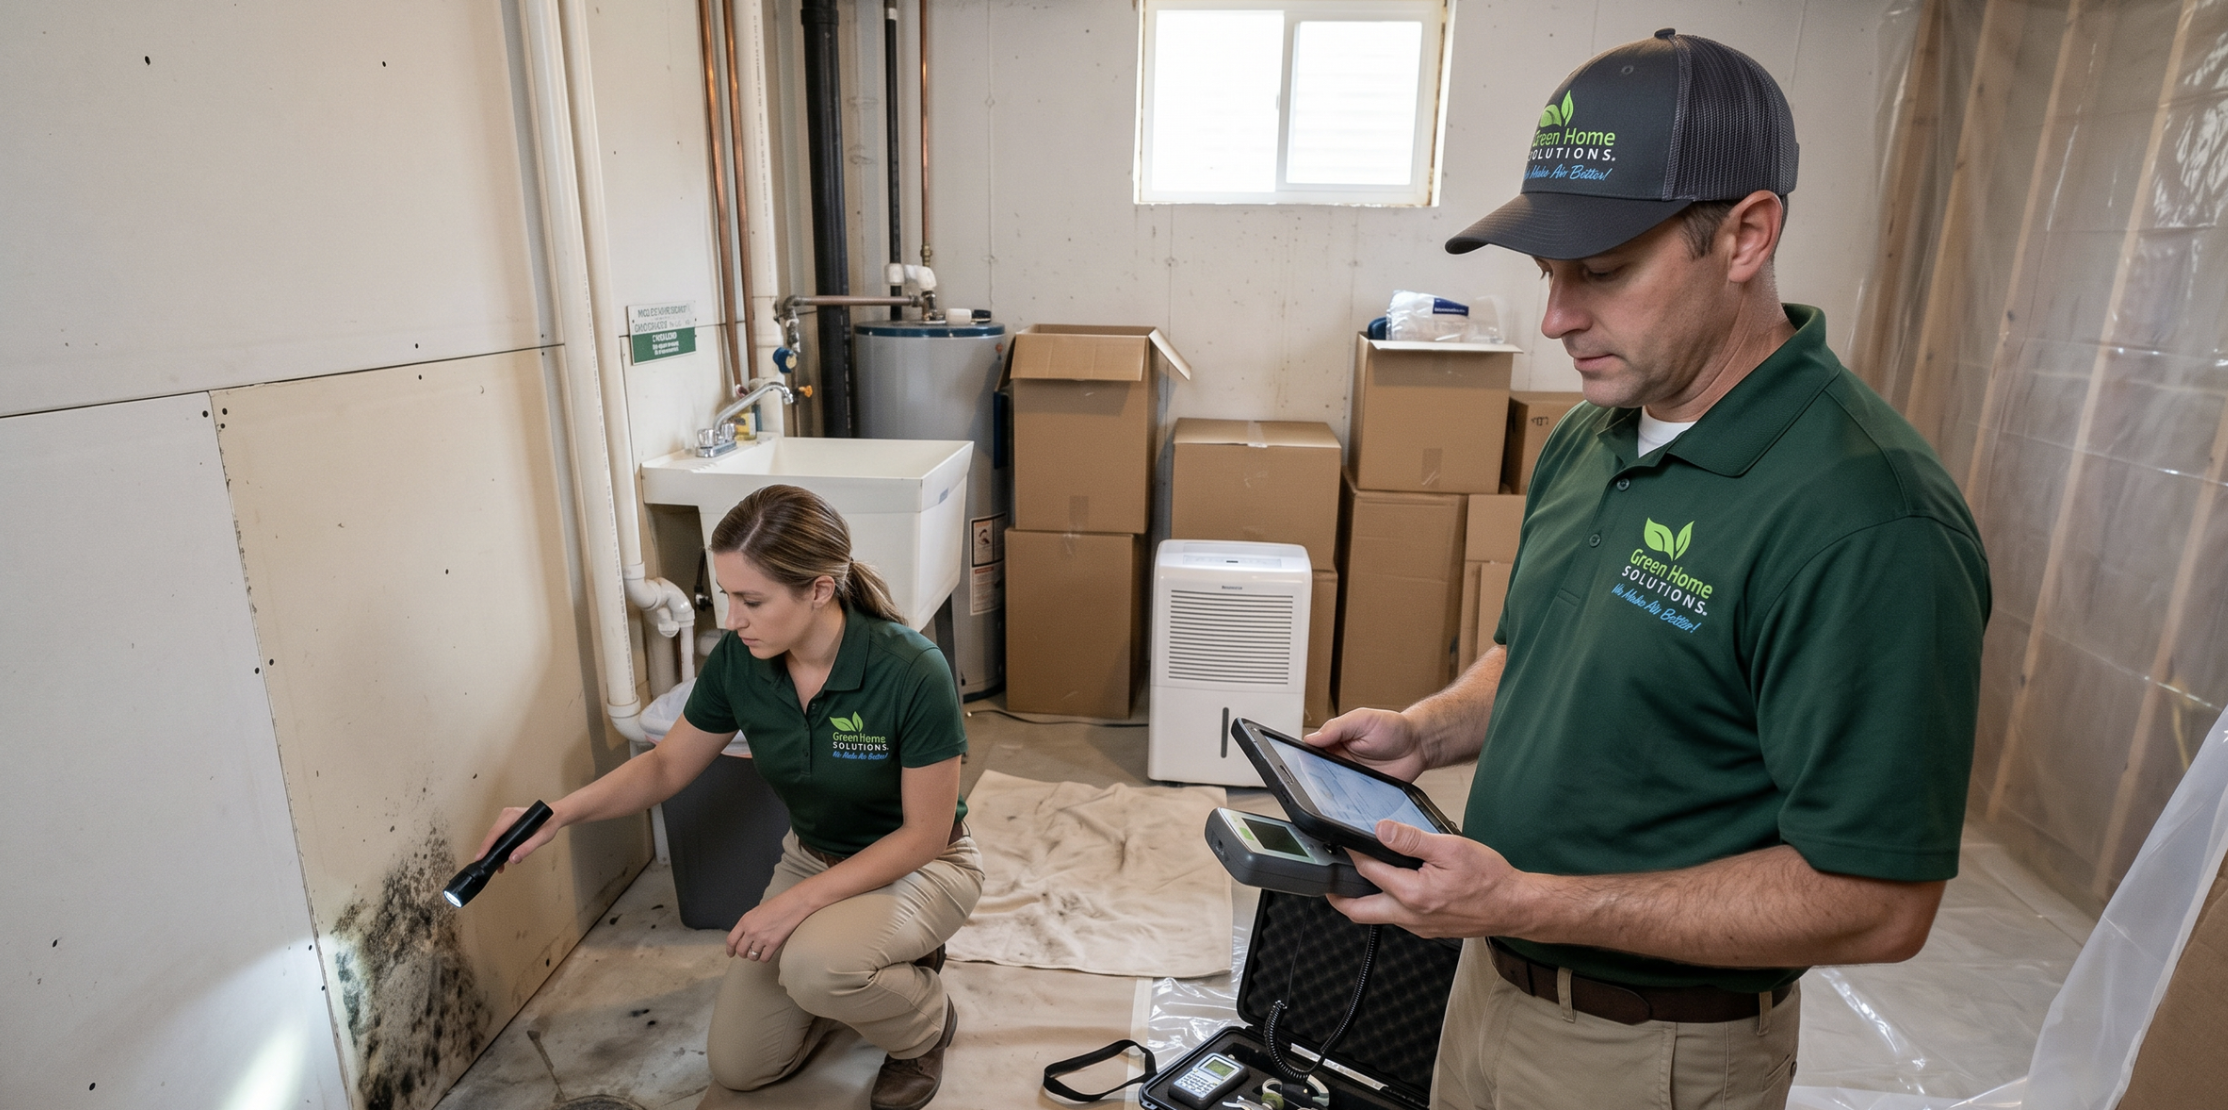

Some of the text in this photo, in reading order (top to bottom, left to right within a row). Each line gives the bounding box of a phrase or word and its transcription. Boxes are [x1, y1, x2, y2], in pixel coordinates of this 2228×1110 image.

[1563, 128, 1616, 147] Home
[1630, 548, 1713, 600] Green Home
[832, 731, 858, 742] Green
